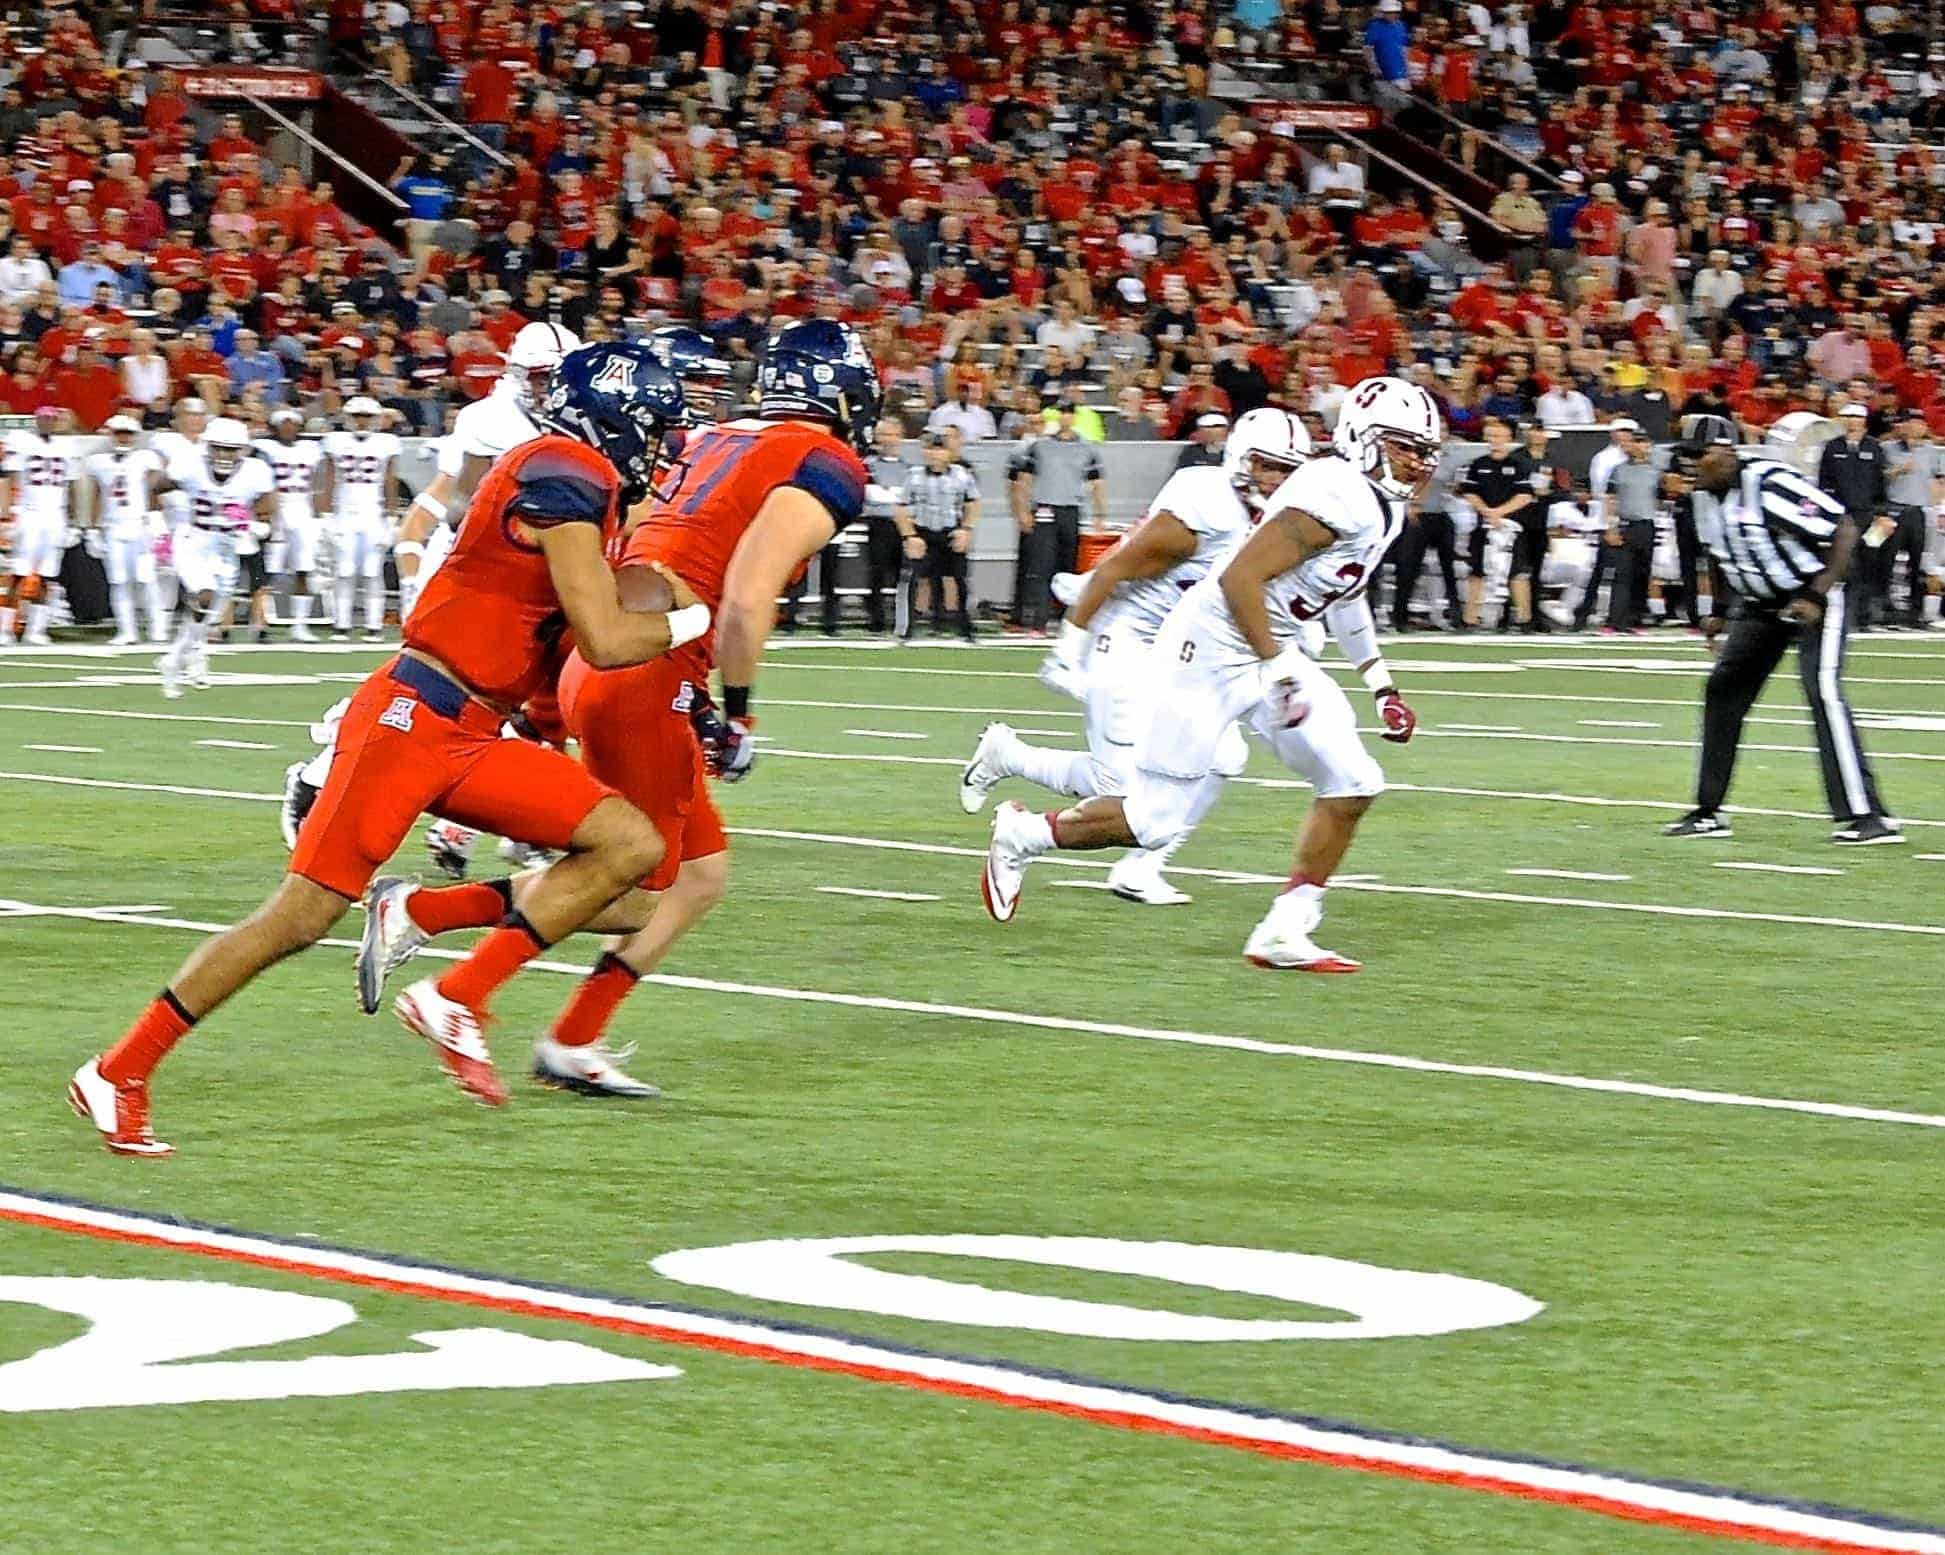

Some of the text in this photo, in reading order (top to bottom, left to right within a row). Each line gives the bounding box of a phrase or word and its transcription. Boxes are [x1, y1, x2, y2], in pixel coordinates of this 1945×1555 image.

[590, 354, 638, 400] A
[1356, 382, 1387, 408] S
[378, 696, 417, 733] A
